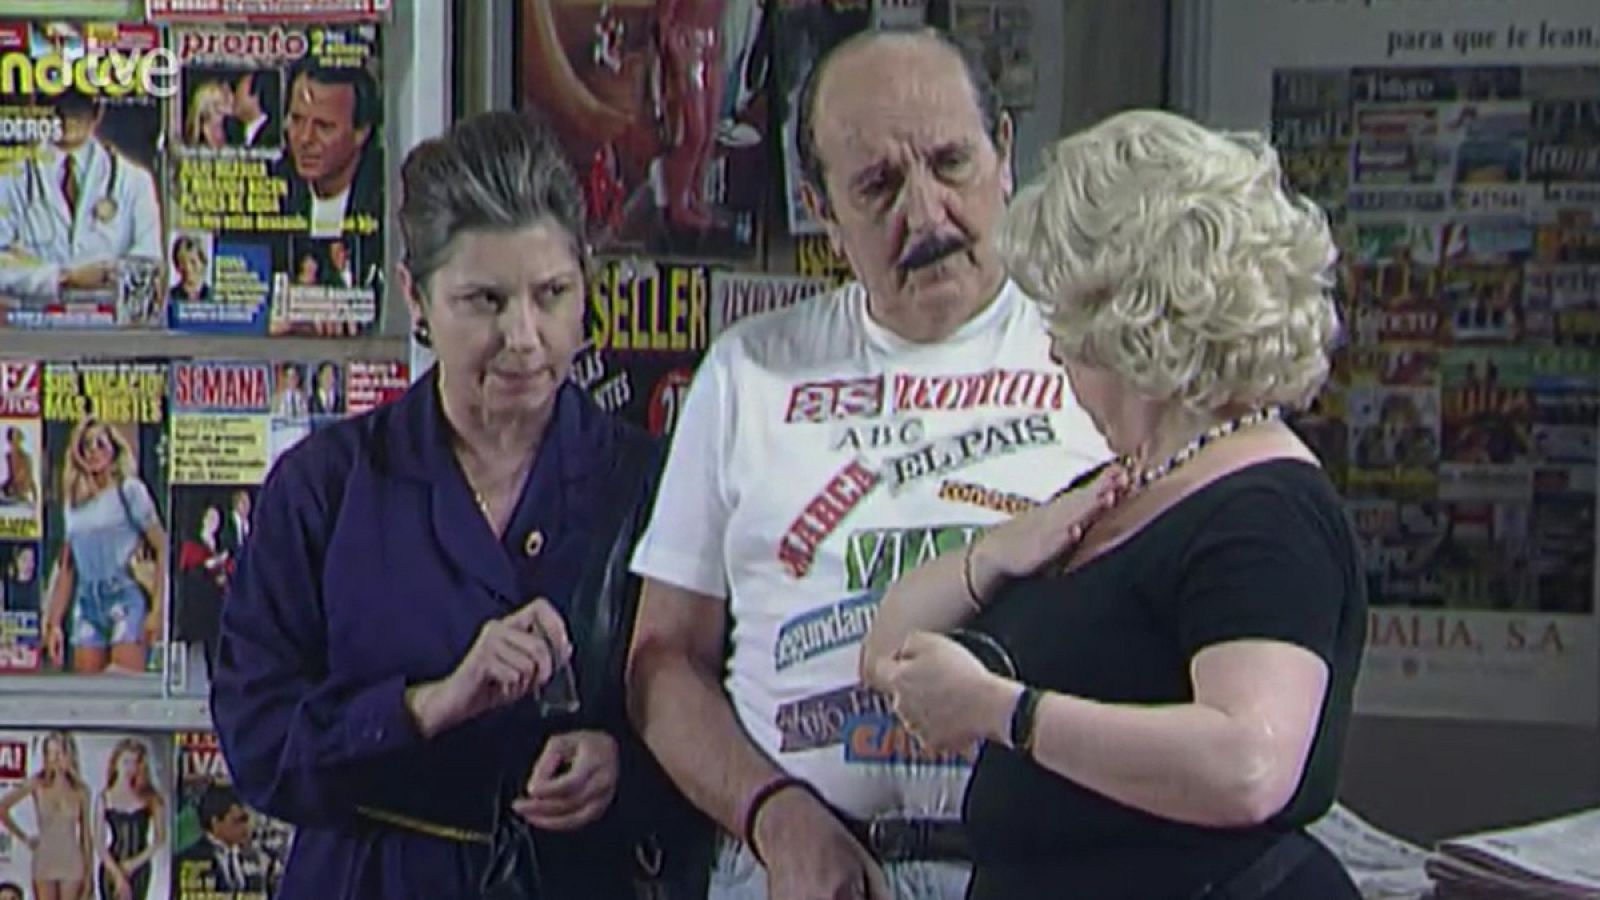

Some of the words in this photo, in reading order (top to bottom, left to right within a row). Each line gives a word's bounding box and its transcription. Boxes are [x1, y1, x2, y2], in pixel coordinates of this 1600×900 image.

[179, 27, 309, 61] pronto
[1387, 26, 1443, 56] para
[1453, 26, 1496, 55] que
[592, 262, 708, 350] SELLER
[175, 363, 268, 407] SEMANA
[836, 417, 926, 451] ABC
[777, 460, 880, 580] MARCA
